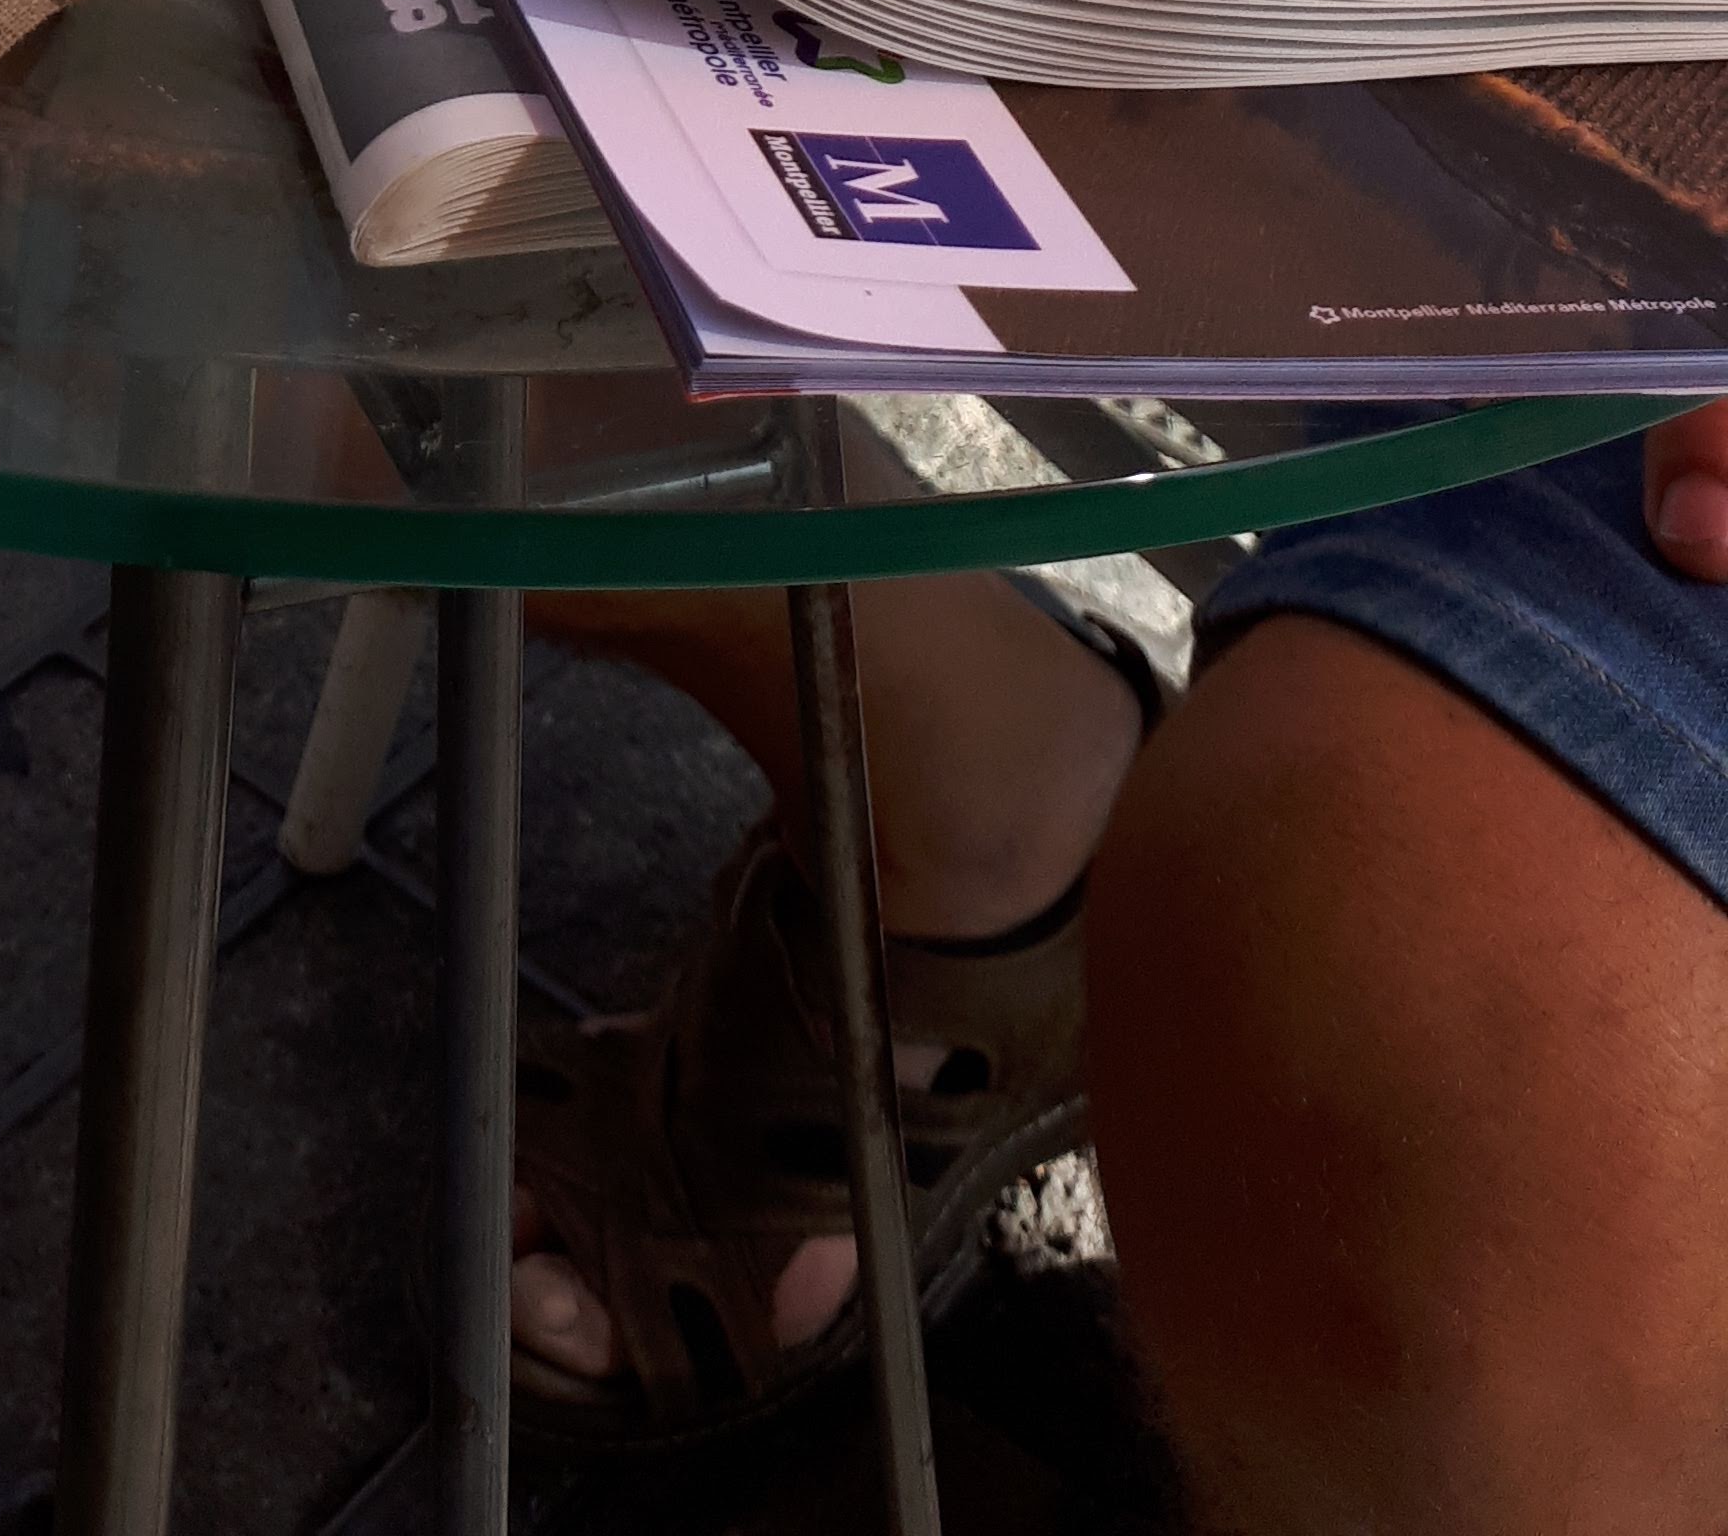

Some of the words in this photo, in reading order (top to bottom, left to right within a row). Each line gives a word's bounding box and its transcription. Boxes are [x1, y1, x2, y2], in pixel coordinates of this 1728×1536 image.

[764, 134, 842, 236] Montpellier
[823, 154, 948, 225] M
[1341, 303, 1461, 321] Montpellier
[1465, 299, 1605, 316] Méditerranée
[1608, 296, 1716, 316] Métropole
